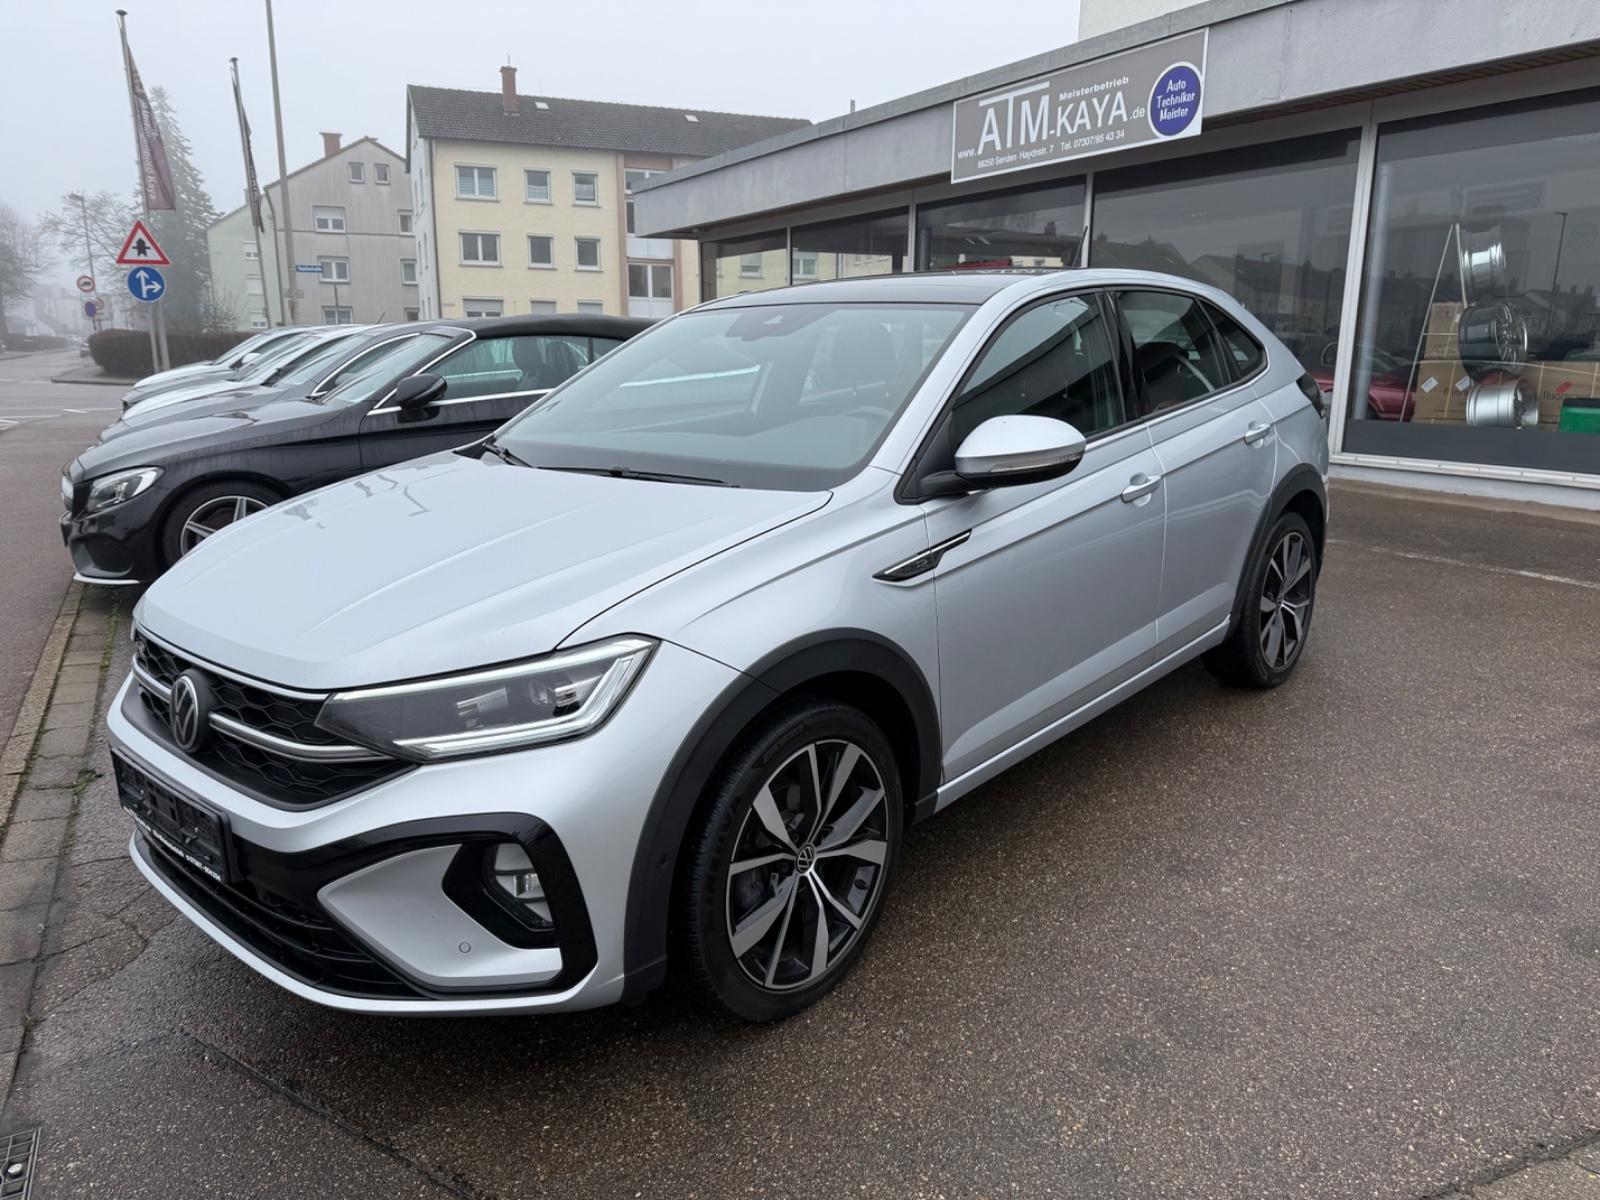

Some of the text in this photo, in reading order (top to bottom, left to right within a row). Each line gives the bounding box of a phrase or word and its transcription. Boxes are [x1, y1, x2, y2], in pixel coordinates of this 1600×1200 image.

[1059, 76, 1129, 101] Meisterbetrieb
[1166, 79, 1187, 93] Auto
[1156, 91, 1195, 109] Techniker
[1159, 107, 1189, 122] Meister
